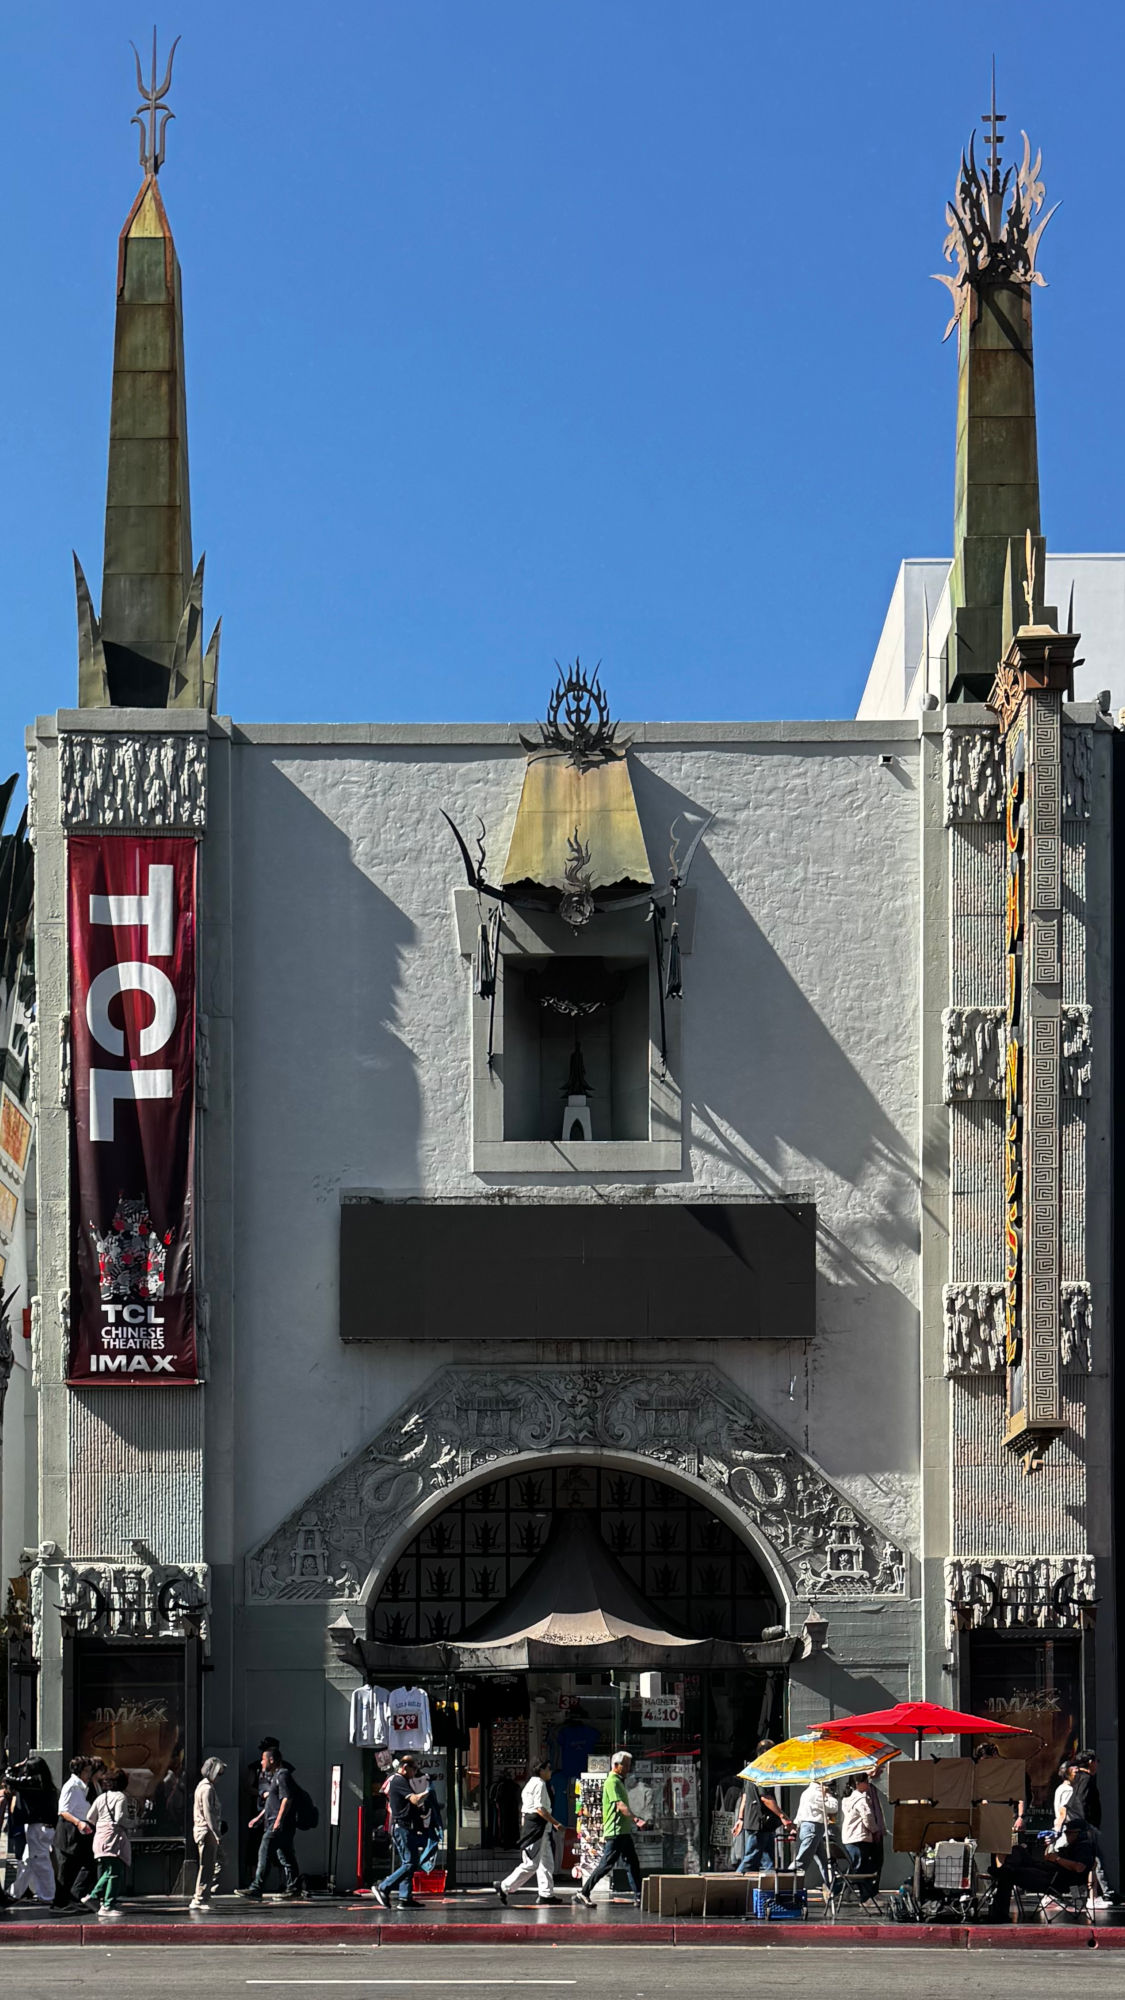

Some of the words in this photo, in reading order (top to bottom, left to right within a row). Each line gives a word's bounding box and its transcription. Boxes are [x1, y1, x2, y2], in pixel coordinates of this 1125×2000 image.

[86, 864, 177, 1142] TCL
[101, 1304, 165, 1324] TCL
[101, 1326, 165, 1339] CHINESE
[101, 1338, 165, 1350] THEATRES
[644, 1698, 678, 1706] MAGNETS
[644, 1708, 654, 1721] 4
